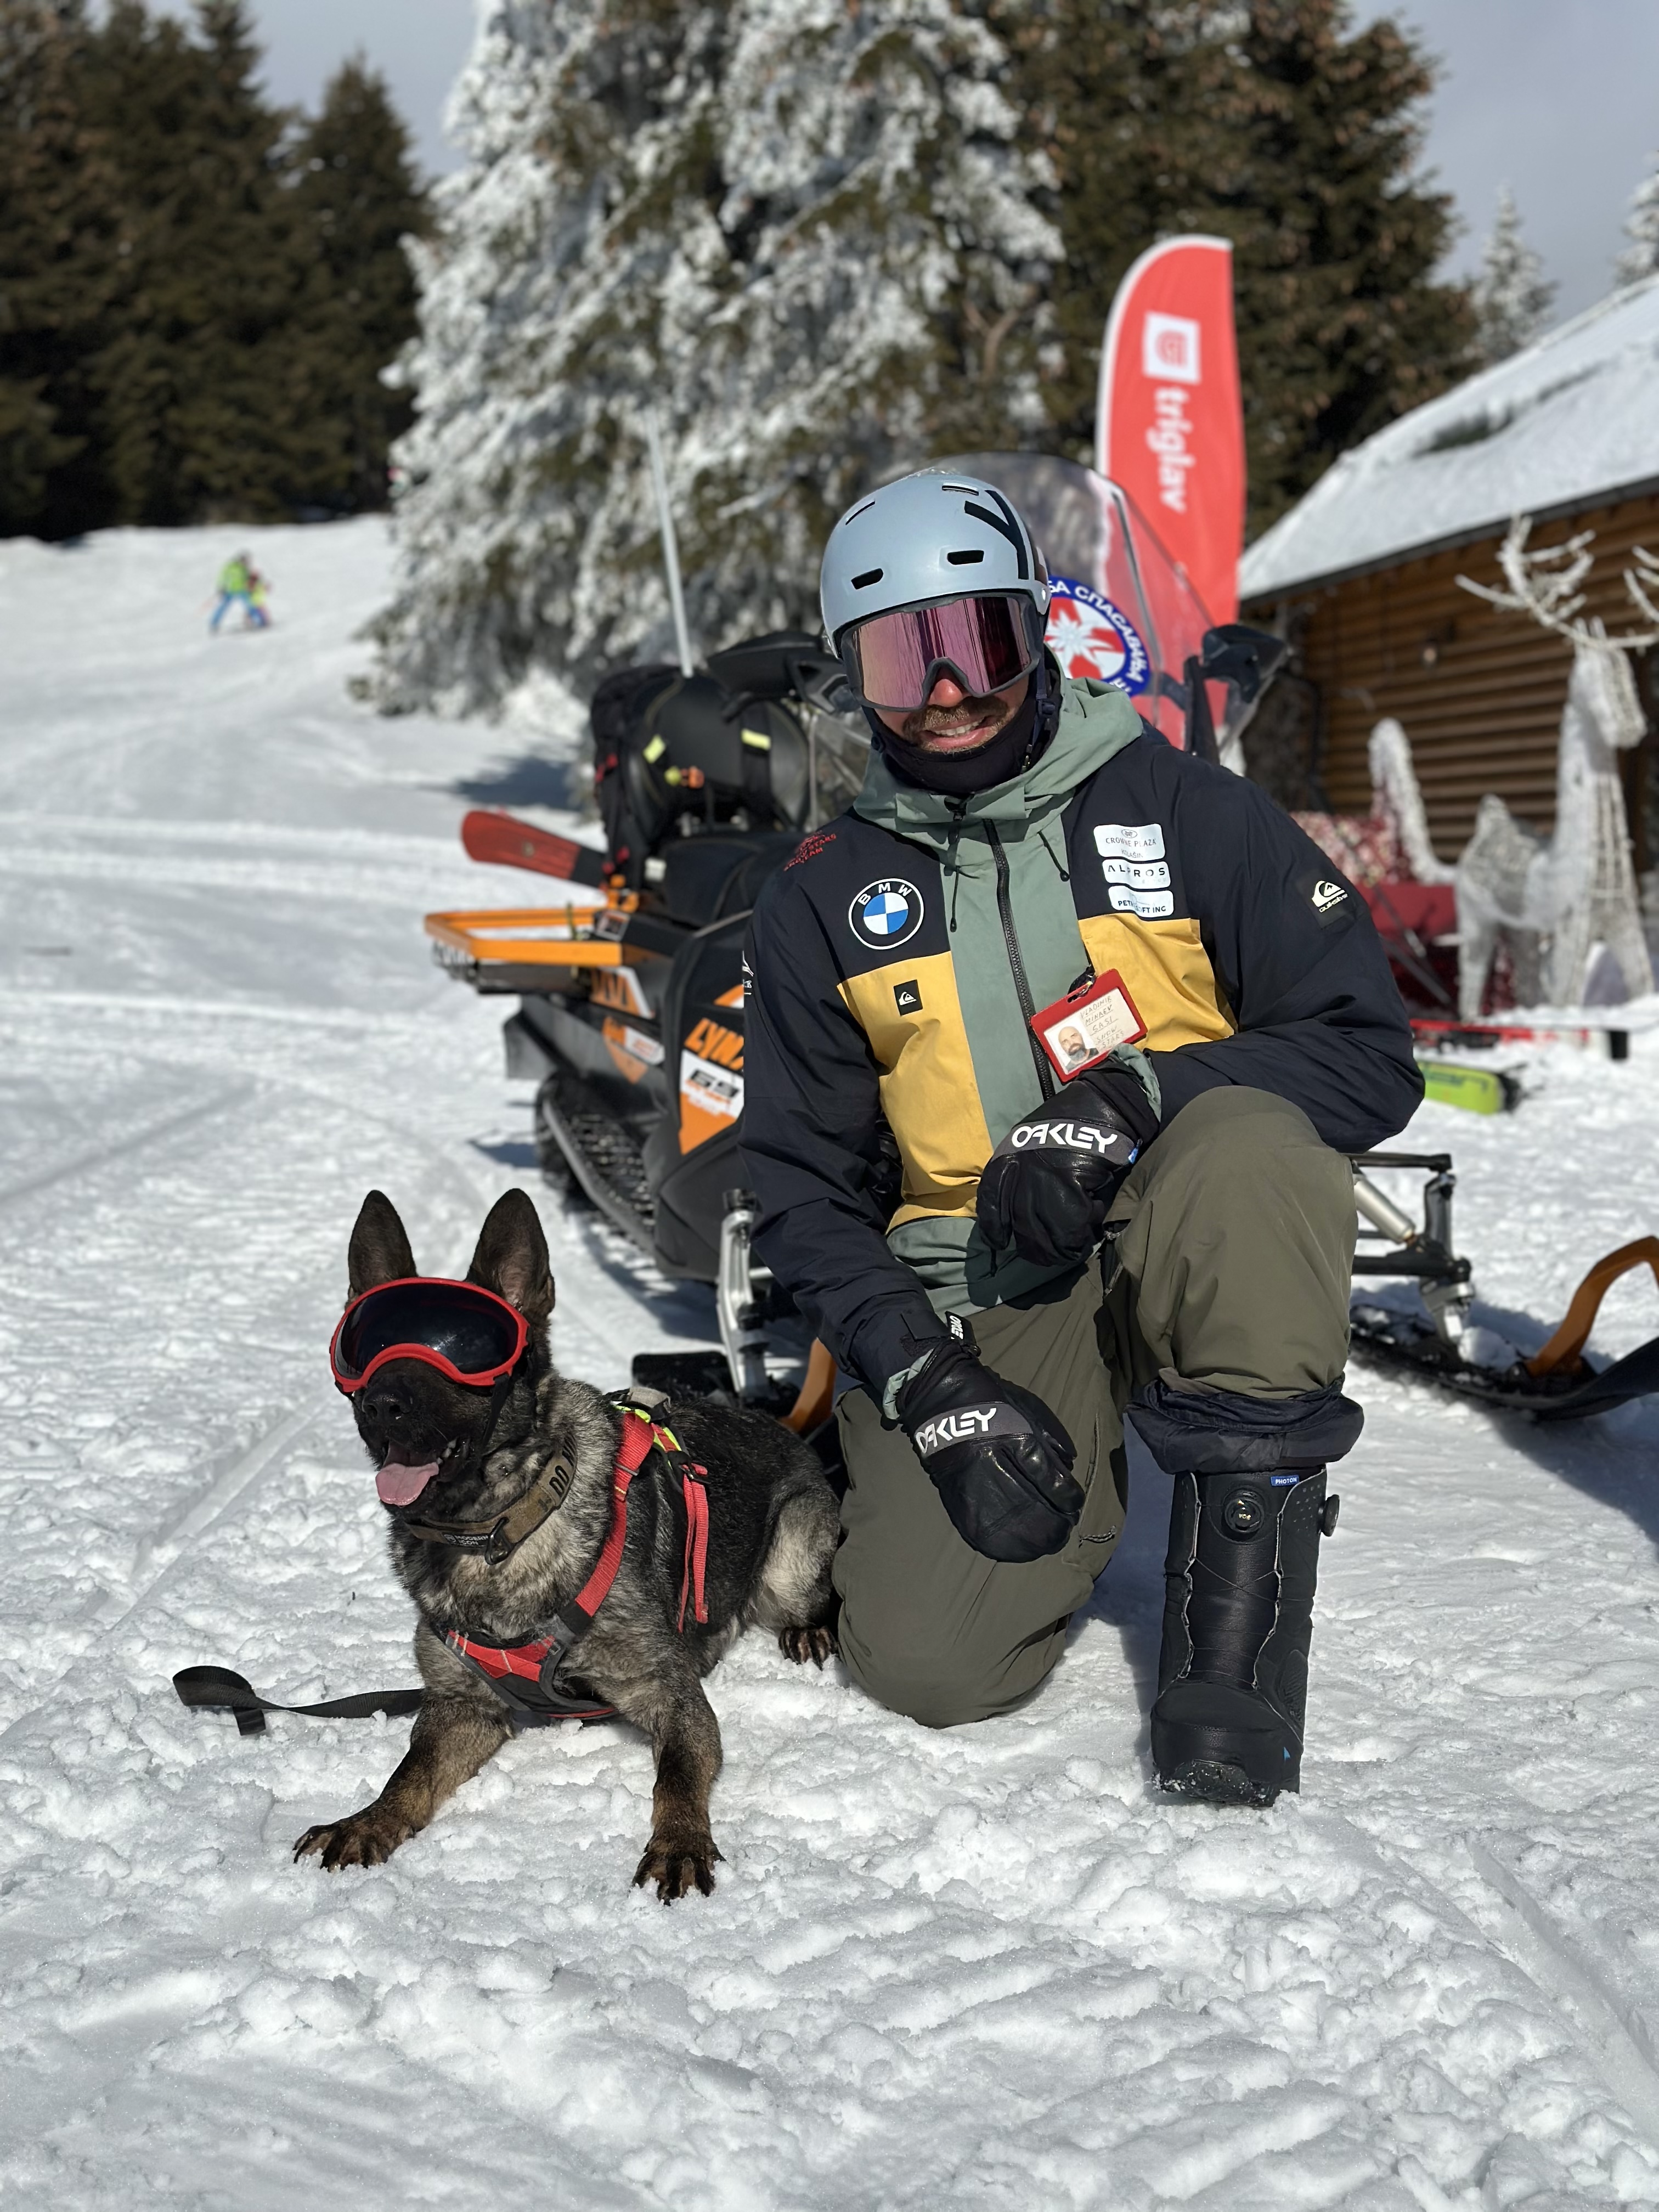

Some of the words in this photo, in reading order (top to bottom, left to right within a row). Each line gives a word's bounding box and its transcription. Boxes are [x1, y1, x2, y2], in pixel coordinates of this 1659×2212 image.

[1145, 387, 1197, 514] triglav
[1105, 838, 1132, 847] CROWNE
[857, 882, 912, 906] BMW
[1012, 1123, 1118, 1154] OAKLEY
[949, 1315, 964, 1340] OAKLE
[916, 1407, 997, 1454] OAKLEY
[549, 1465, 569, 1498] DO
